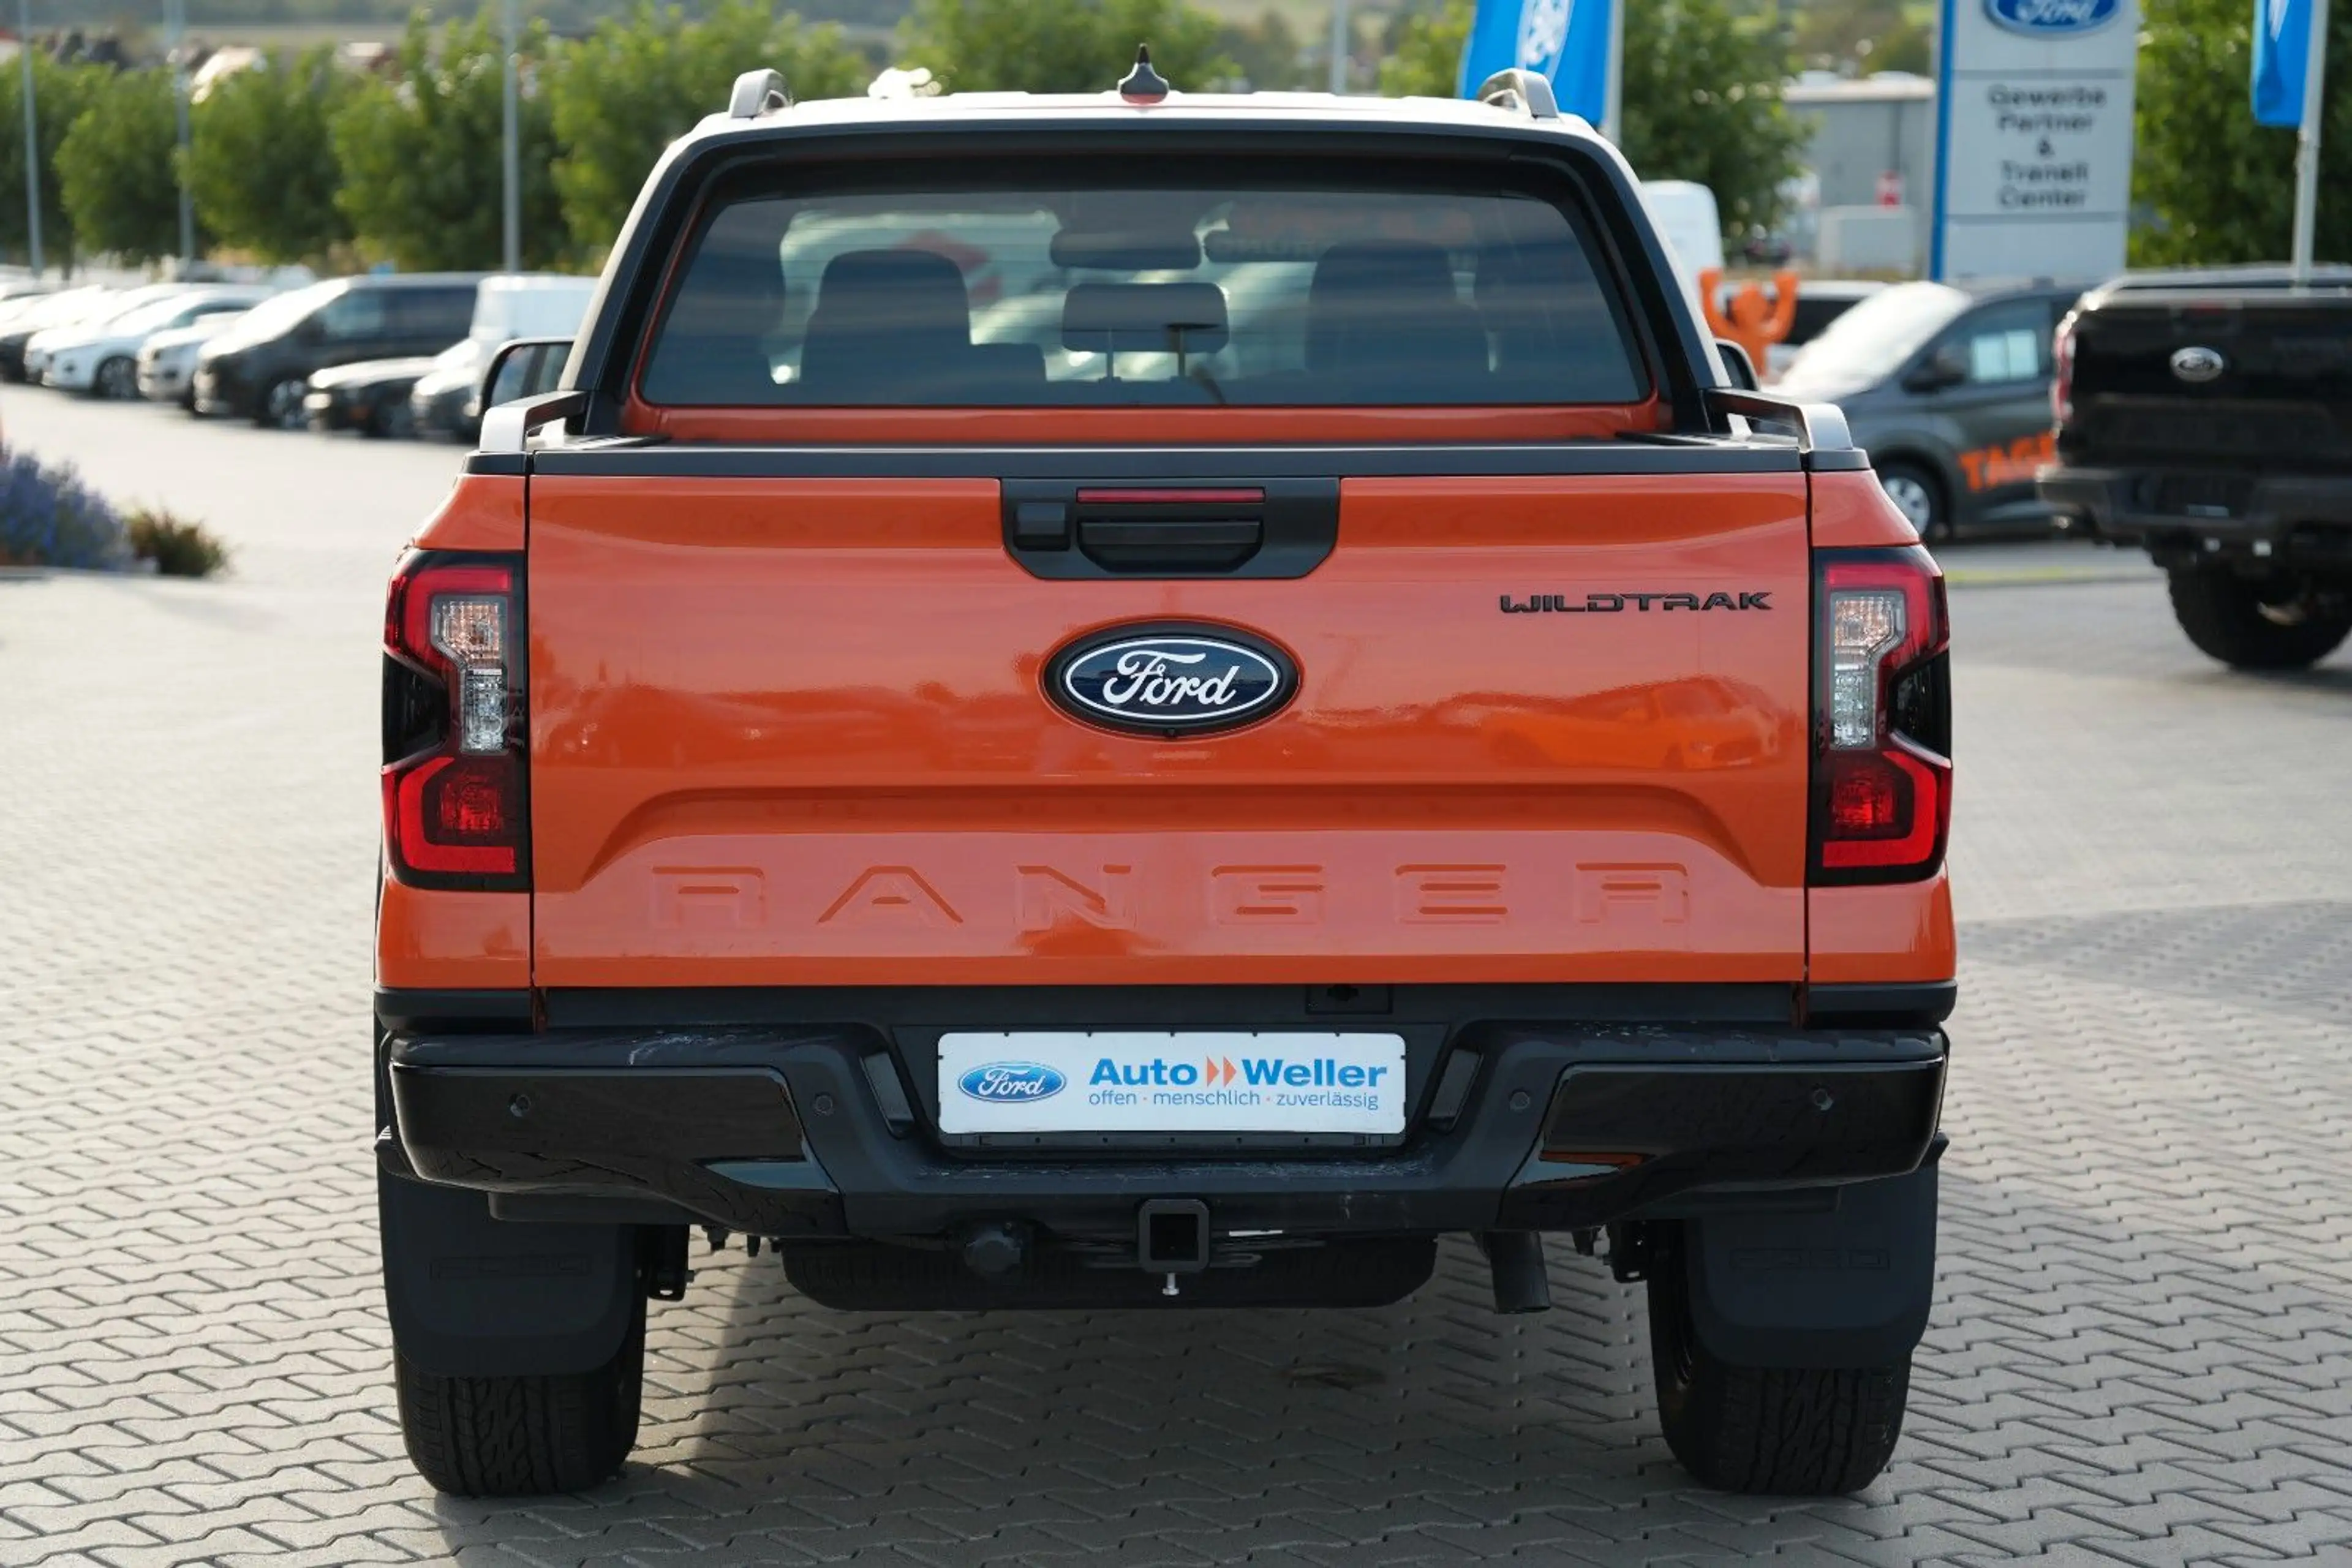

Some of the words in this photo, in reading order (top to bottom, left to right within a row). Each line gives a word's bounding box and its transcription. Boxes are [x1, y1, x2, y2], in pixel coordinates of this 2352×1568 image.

[1989, 85, 2106, 108] Gewerbe
[1999, 114, 2092, 133] Partner
[2038, 138, 2054, 156] &
[2002, 160, 2089, 181] Transit
[1999, 187, 2086, 207] Center
[1500, 592, 1773, 613] WILDTRAK
[1102, 649, 1240, 706] Ford
[651, 864, 1691, 926] RANGER
[977, 1066, 1045, 1096] Ford
[1089, 1058, 1198, 1087] Auto
[1242, 1058, 1387, 1087] Weller
[1089, 1090, 1137, 1106] offen
[1153, 1089, 1260, 1106] menschlich
[1276, 1091, 1379, 1110] zuverlässig
